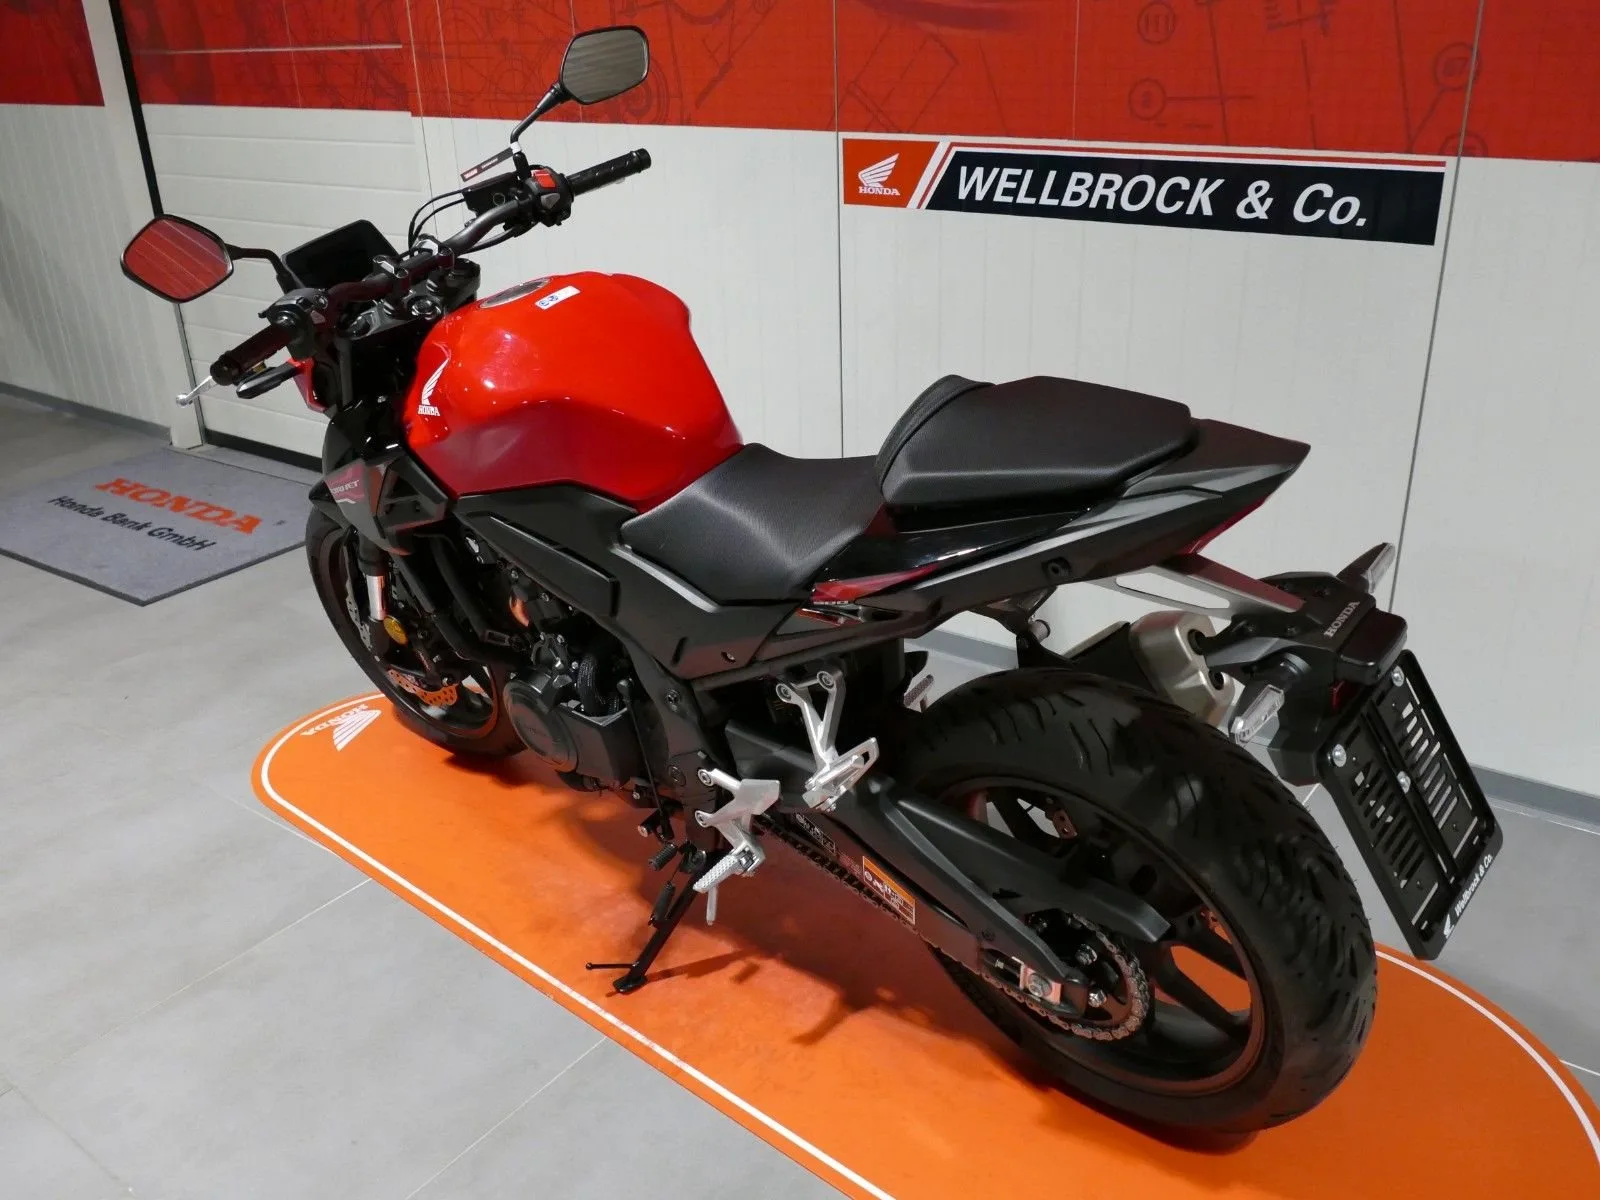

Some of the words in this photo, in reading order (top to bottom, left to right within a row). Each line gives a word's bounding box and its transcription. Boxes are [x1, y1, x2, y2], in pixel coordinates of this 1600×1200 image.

[858, 186, 901, 196] HONDA
[958, 166, 1225, 215] WELLBROCK
[1235, 181, 1276, 221] &
[1293, 182, 1367, 226] Co.
[418, 405, 441, 417] HONDA
[48, 496, 104, 518] Honda
[101, 512, 153, 533] Bank
[147, 526, 218, 551] GmbH
[95, 478, 262, 535] HONDA
[1323, 601, 1361, 637] HONDA
